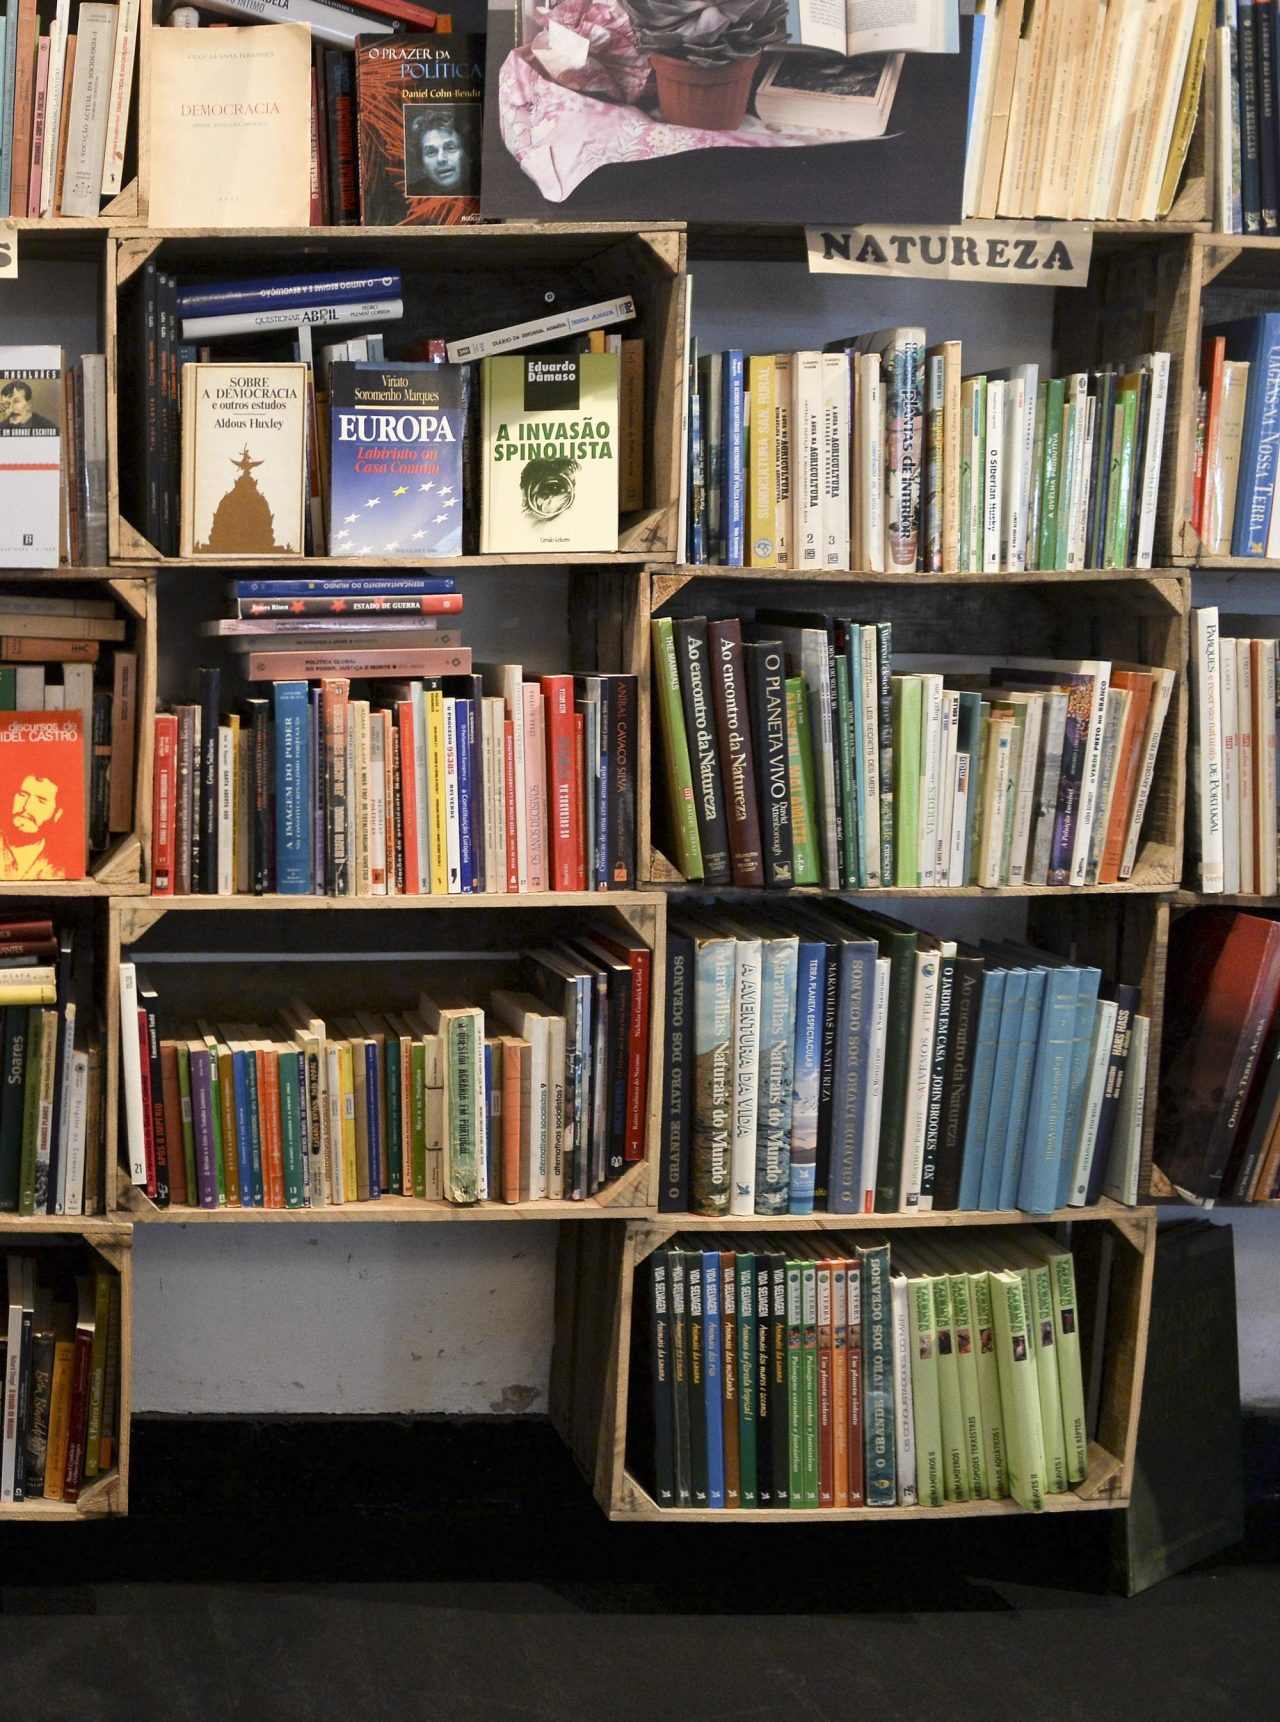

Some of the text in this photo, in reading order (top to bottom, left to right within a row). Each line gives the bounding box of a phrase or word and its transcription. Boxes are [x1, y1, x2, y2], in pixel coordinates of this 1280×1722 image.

[369, 48, 450, 60] O PRAZER DA
[401, 59, 482, 79] POLÍTICA
[402, 88, 428, 98] Daniel
[181, 103, 280, 117] DEMOCRACIA
[821, 232, 1074, 270] NATUREZA
[302, 308, 339, 324] ABRIL
[4, 370, 56, 379] MAGALHÃES
[528, 361, 576, 372] Eduardo
[528, 372, 576, 382] Dâmaso
[230, 377, 269, 388] SOBRE
[382, 375, 409, 387] Viriato
[202, 388, 297, 399] A DEMOCRACIA
[219, 401, 249, 410] outros
[251, 400, 286, 410] estudos
[355, 389, 439, 402] Soromenho Marques
[214, 418, 284, 430] Aldous Huxley
[338, 414, 456, 442] EUROPA
[497, 417, 610, 441] A INVASÃO
[358, 447, 418, 460] Labirinto
[494, 442, 612, 461] SPINOLISTA
[1050, 432, 1059, 477] PRODUTIVA
[355, 462, 440, 474] Casa Comum
[989, 459, 997, 500] Siberian
[1049, 479, 1057, 511] OVELHA
[324, 580, 350, 589] MUNDO
[352, 580, 361, 589] DO
[354, 602, 380, 610] ESTADO
[382, 602, 391, 610] DE
[1206, 624, 1218, 673] PARQUES
[666, 636, 679, 690] THE MAMMALS
[1098, 680, 1107, 712] BRANCO
[9, 722, 58, 732] discursos
[688, 636, 717, 820] Ao encontro da Natureza
[720, 637, 747, 820] Ao encontro da Natureza
[765, 654, 786, 798] O PLANETA VIVO
[1097, 714, 1103, 724] NO
[29, 731, 77, 742] CASTRO
[284, 717, 293, 758] PODER
[1093, 727, 1102, 751] PRETO
[284, 763, 293, 782] DO
[1090, 754, 1099, 777] VERDE
[1209, 764, 1217, 777] DE
[284, 787, 293, 836] IMAGEM
[779, 801, 788, 823] David
[1210, 780, 1220, 834] PORTUGAL
[771, 802, 782, 855] Attenborough
[805, 959, 817, 1067] TERRA PLANETA ESPECTACULAR
[1112, 1009, 1130, 1055] HANS HASS
[8, 1035, 24, 1084] Soares
[737, 963, 756, 1138] A AVENTURA DA VIDA
[670, 956, 684, 1198] O GRANDE LIVRO DOS OCEANOS
[554, 1090, 562, 1129] socialistas
[554, 1131, 562, 1175] alternativas
[655, 1267, 666, 1313] VIDA SELVAGEM
[705, 1268, 717, 1315] VIDA SELVAGEM
[739, 1270, 752, 1316] VIDA SELVAGEM
